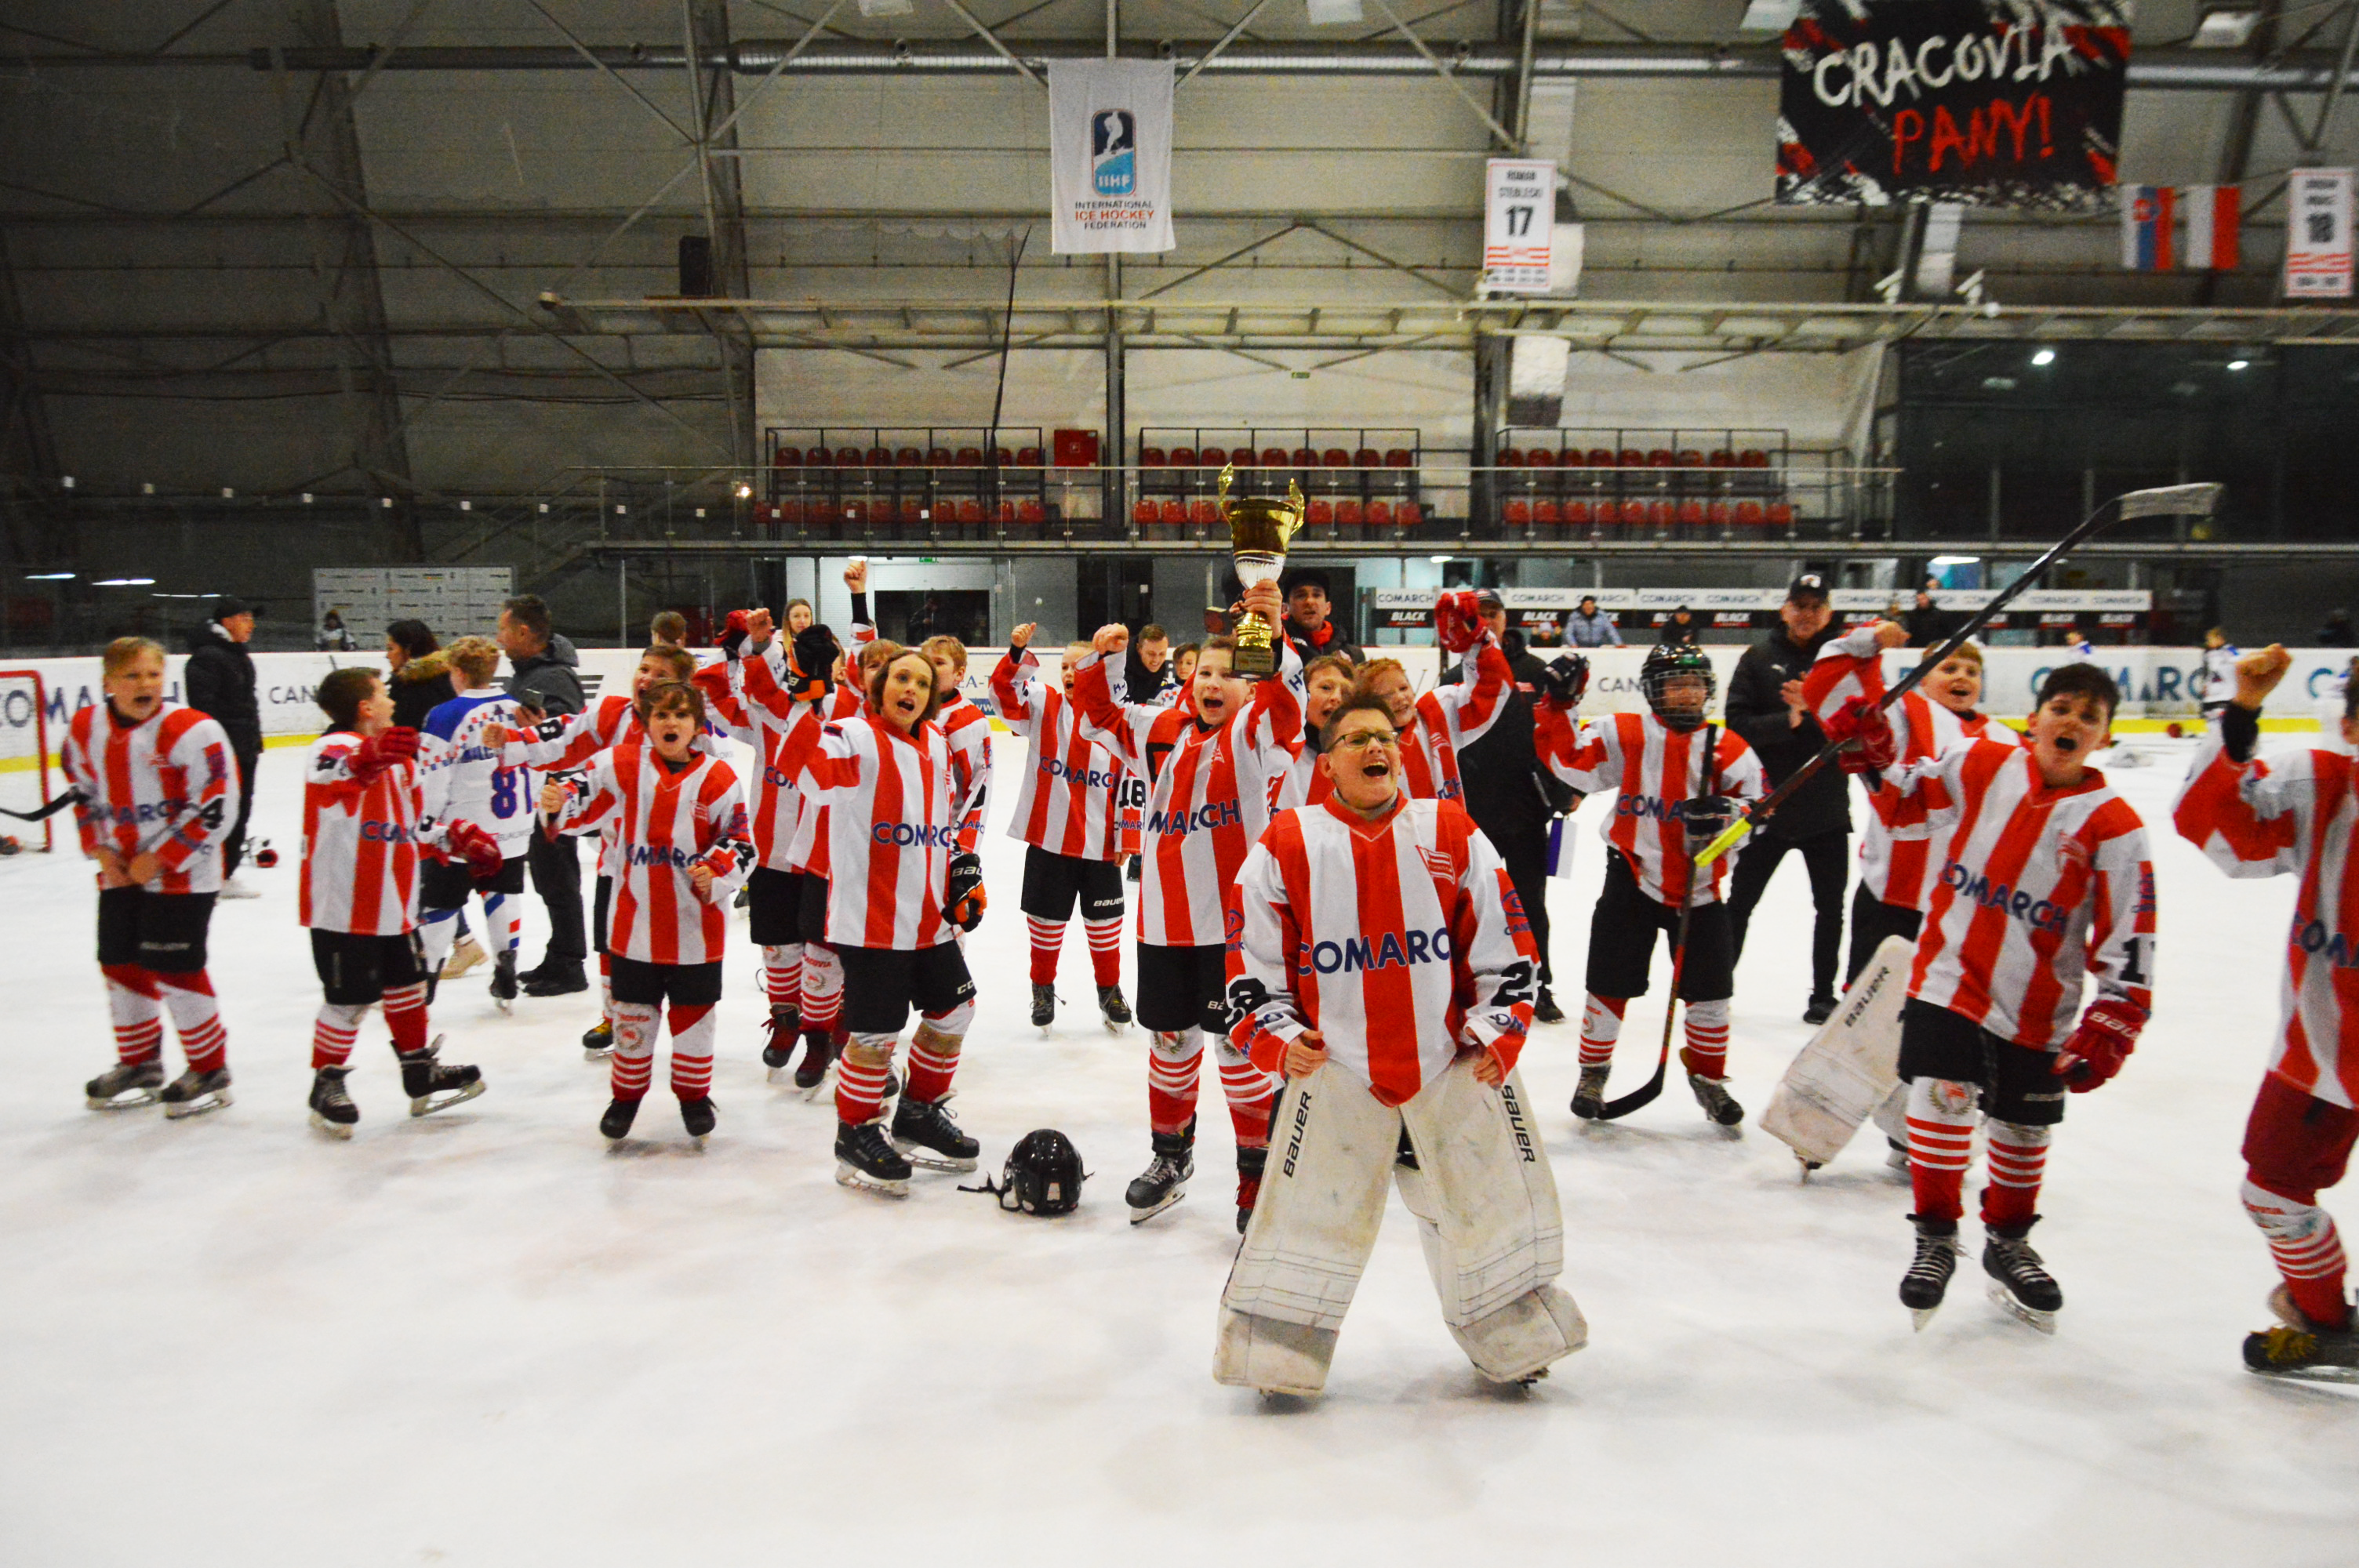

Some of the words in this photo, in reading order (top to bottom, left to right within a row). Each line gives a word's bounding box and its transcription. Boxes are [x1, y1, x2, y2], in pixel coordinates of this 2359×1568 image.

[1813, 9, 2085, 107] CRACOVIA
[1099, 174, 1131, 188] IIHF
[1075, 201, 1154, 209] INTERNATIONAL
[1075, 210, 1096, 220] ICE
[1101, 210, 1154, 220] HOCKEY
[1506, 205, 1533, 235] 17
[1085, 221, 1147, 230] FEDERATION
[1378, 593, 1434, 603] COMARCH
[1510, 593, 1565, 603] COMARCH
[1390, 612, 1427, 622] BLACK
[1521, 611, 1558, 622] BLACK
[490, 766, 533, 820] 81
[1844, 966, 1890, 1028] BAUER
[1501, 1084, 1536, 1163] BAUER
[1283, 1091, 1313, 1178] BAUER
